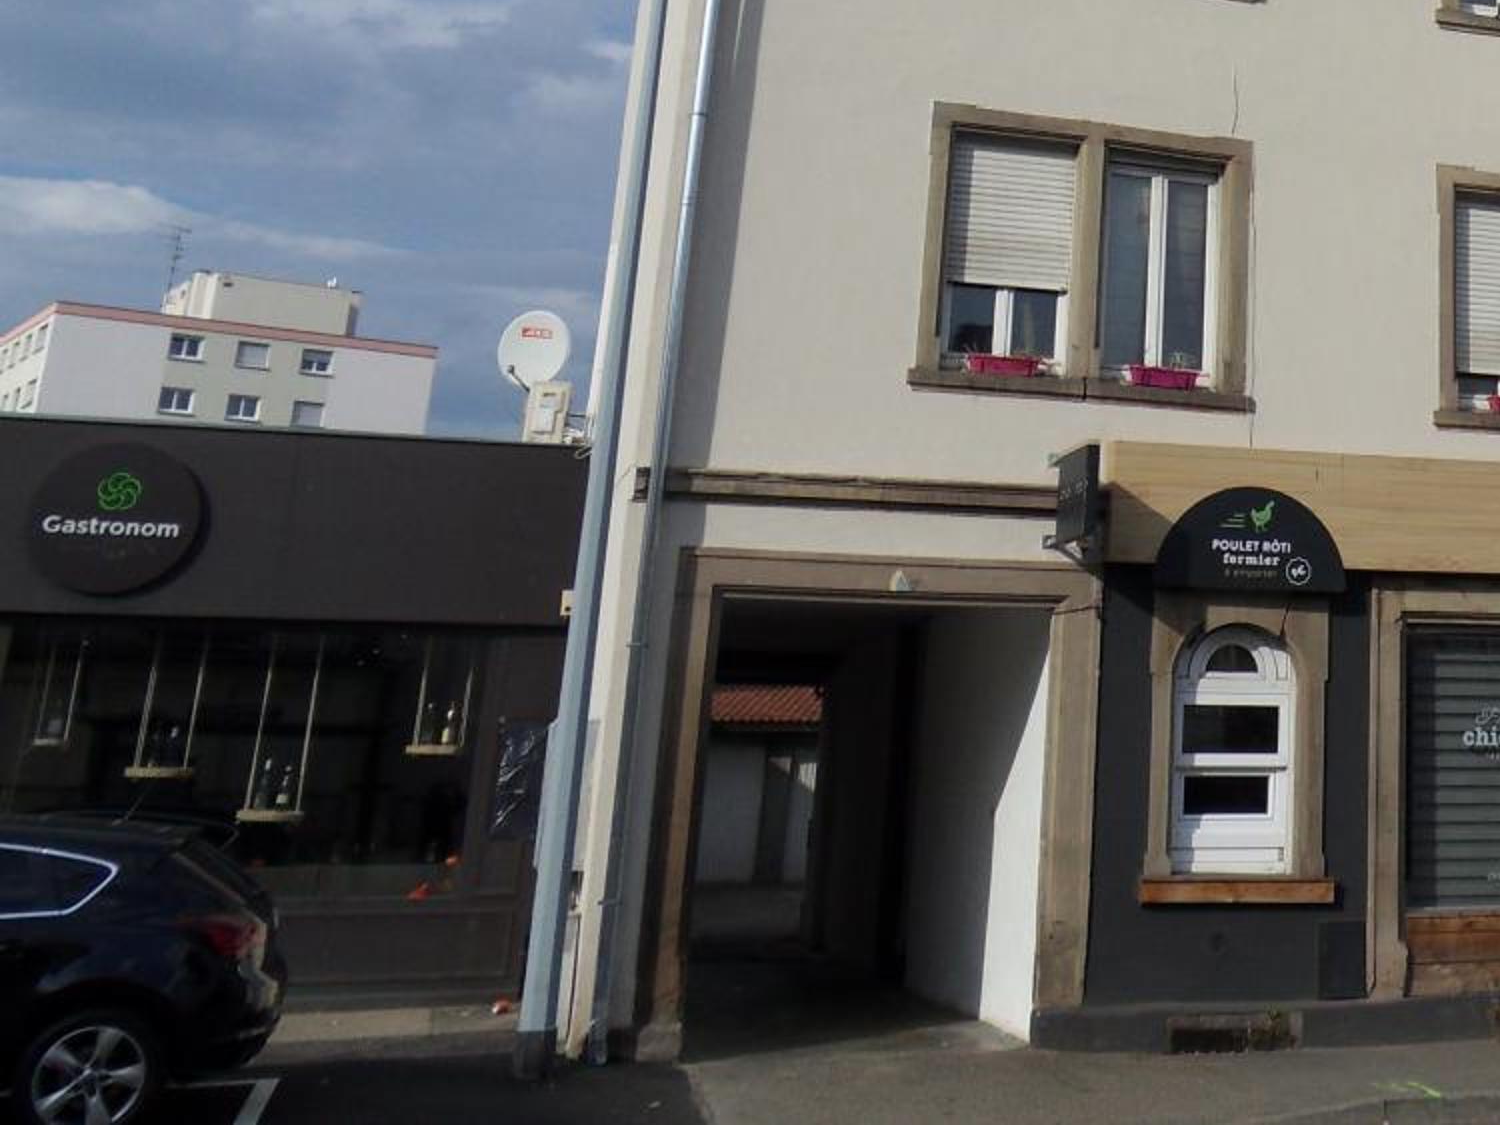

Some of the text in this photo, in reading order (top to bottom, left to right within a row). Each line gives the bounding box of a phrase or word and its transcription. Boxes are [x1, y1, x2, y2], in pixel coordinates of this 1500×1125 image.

[42, 514, 180, 538] Gastronom
[1211, 538, 1292, 554] POULET RÔTI
[1223, 553, 1281, 566] fermier
